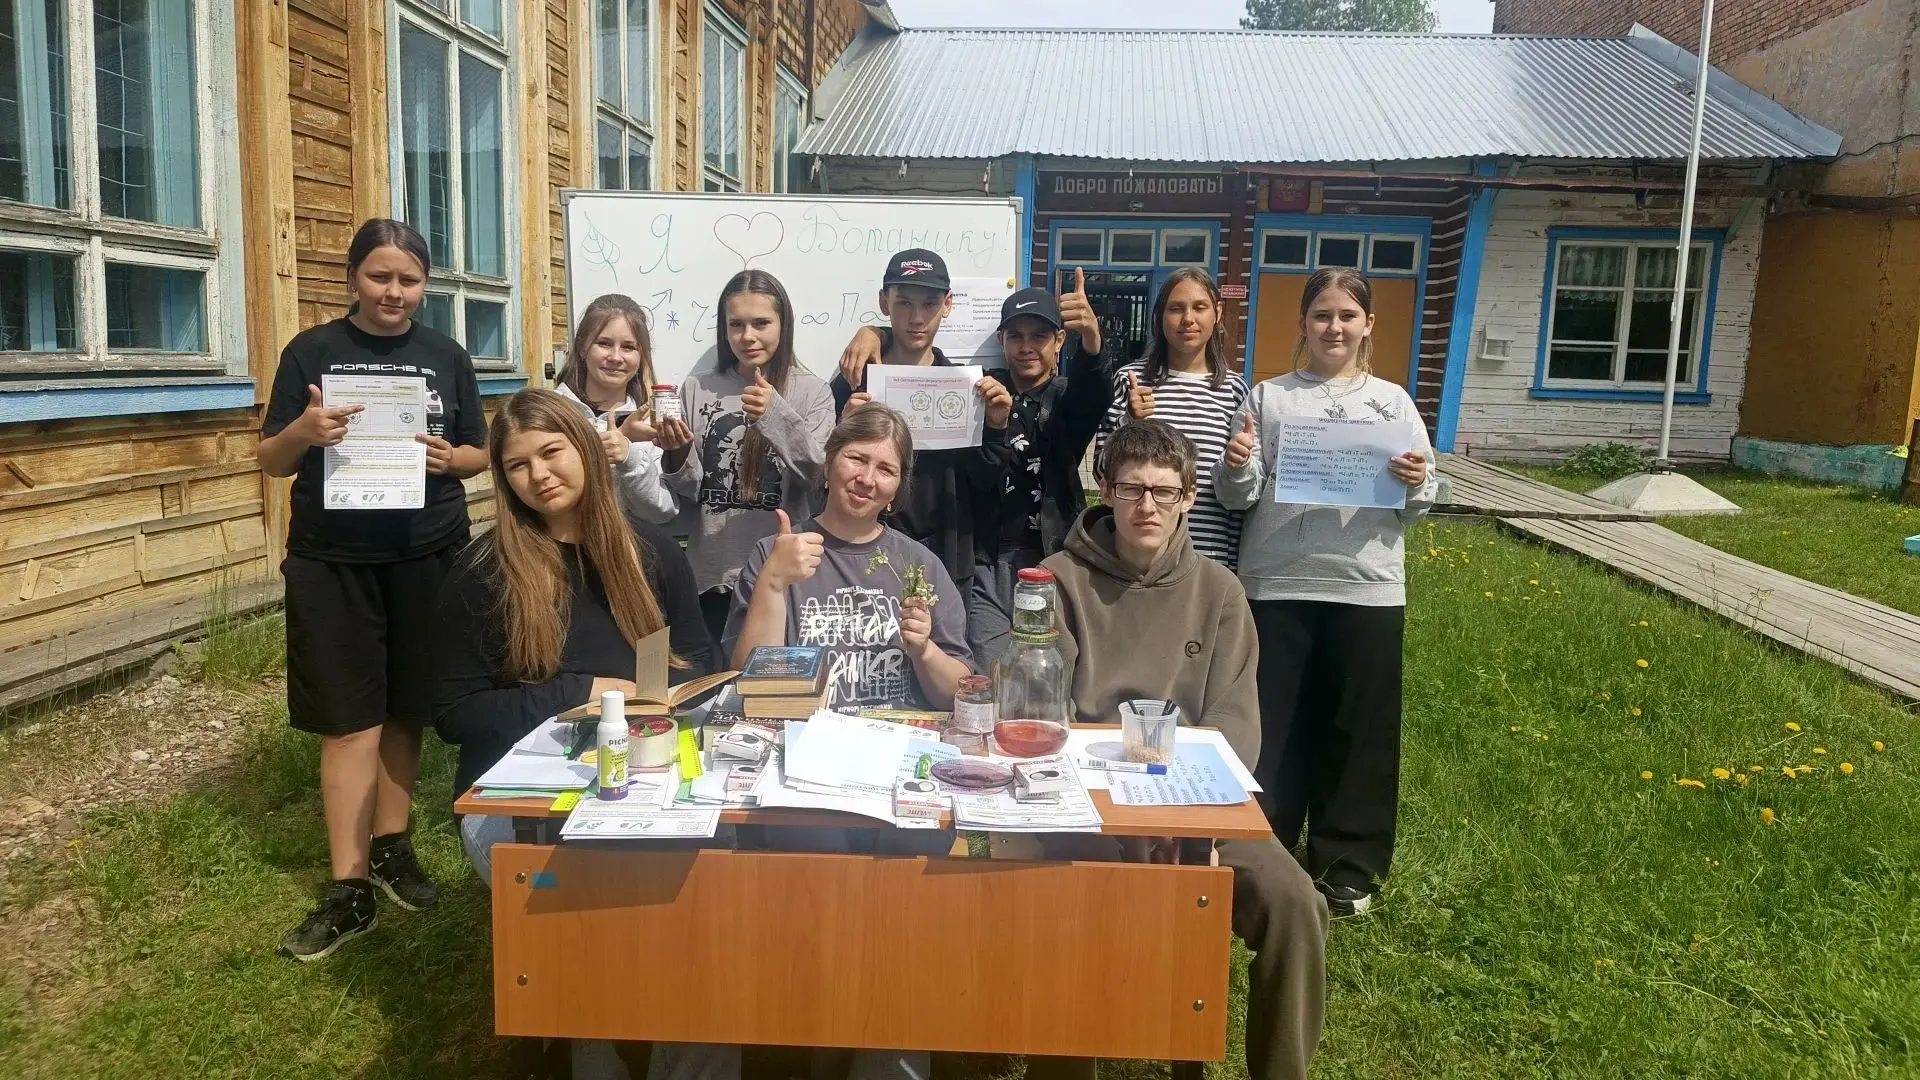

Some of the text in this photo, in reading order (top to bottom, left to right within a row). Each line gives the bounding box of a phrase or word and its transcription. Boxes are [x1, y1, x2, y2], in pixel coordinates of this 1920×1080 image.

[1054, 175, 1223, 194] ДОБРО ПОЖАЛОВАТЬ!
[796, 203, 1011, 268] Ботанику!
[901, 260, 933, 269] Reebok
[330, 364, 417, 373] PORSCHE
